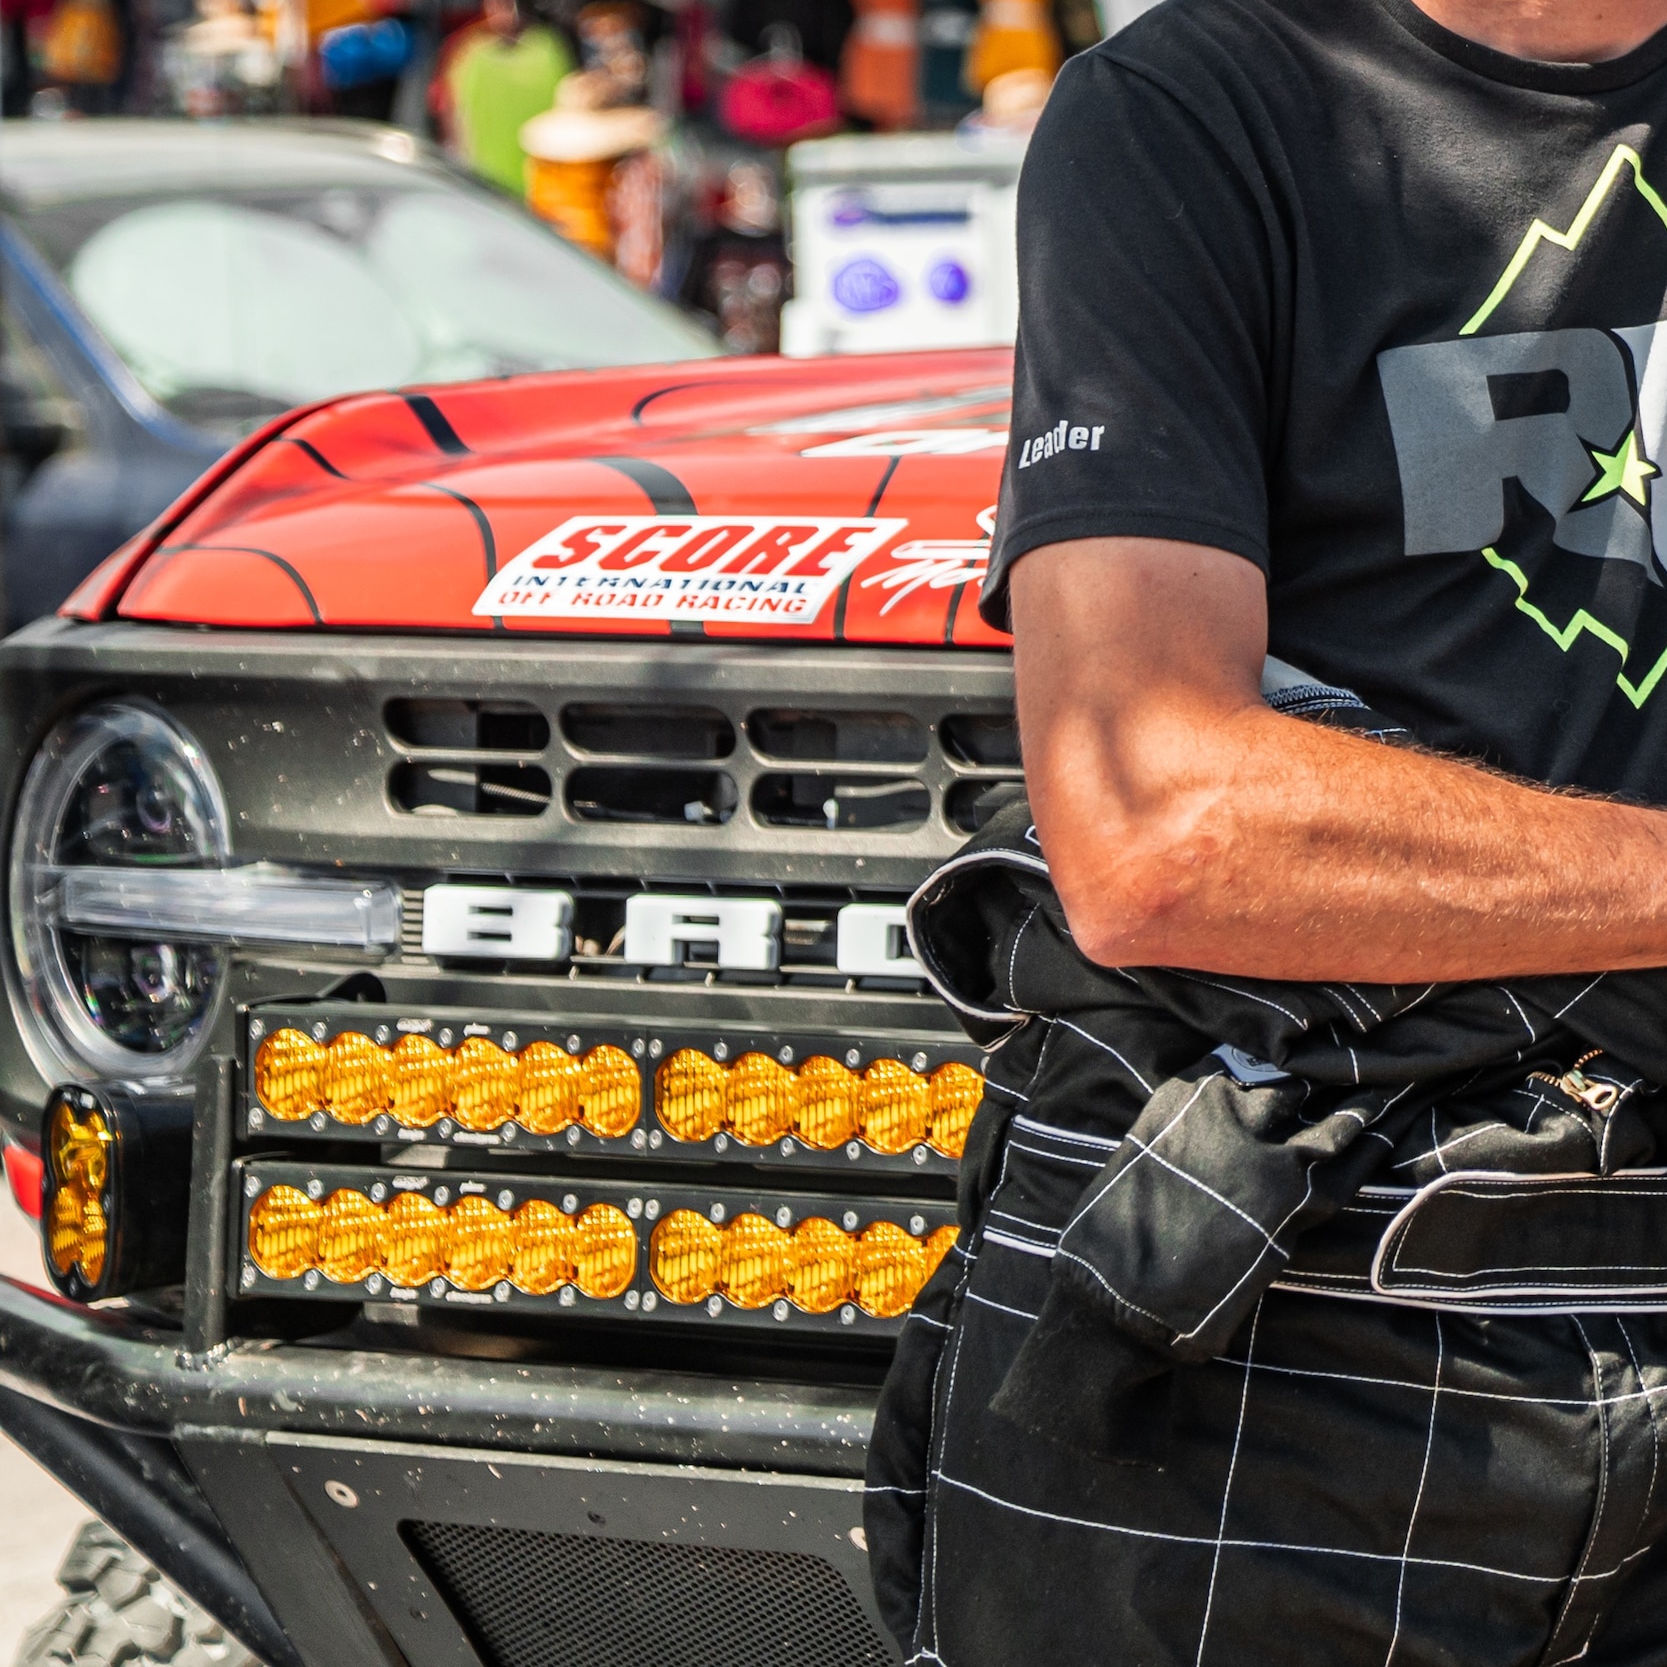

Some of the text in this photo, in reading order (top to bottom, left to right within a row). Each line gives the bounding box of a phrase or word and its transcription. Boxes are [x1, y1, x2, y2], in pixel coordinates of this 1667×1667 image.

[1017, 420, 1106, 470] Leader
[531, 523, 877, 577] SCORE
[513, 575, 806, 595] INTERNATIONAL
[675, 594, 808, 613] RACING
